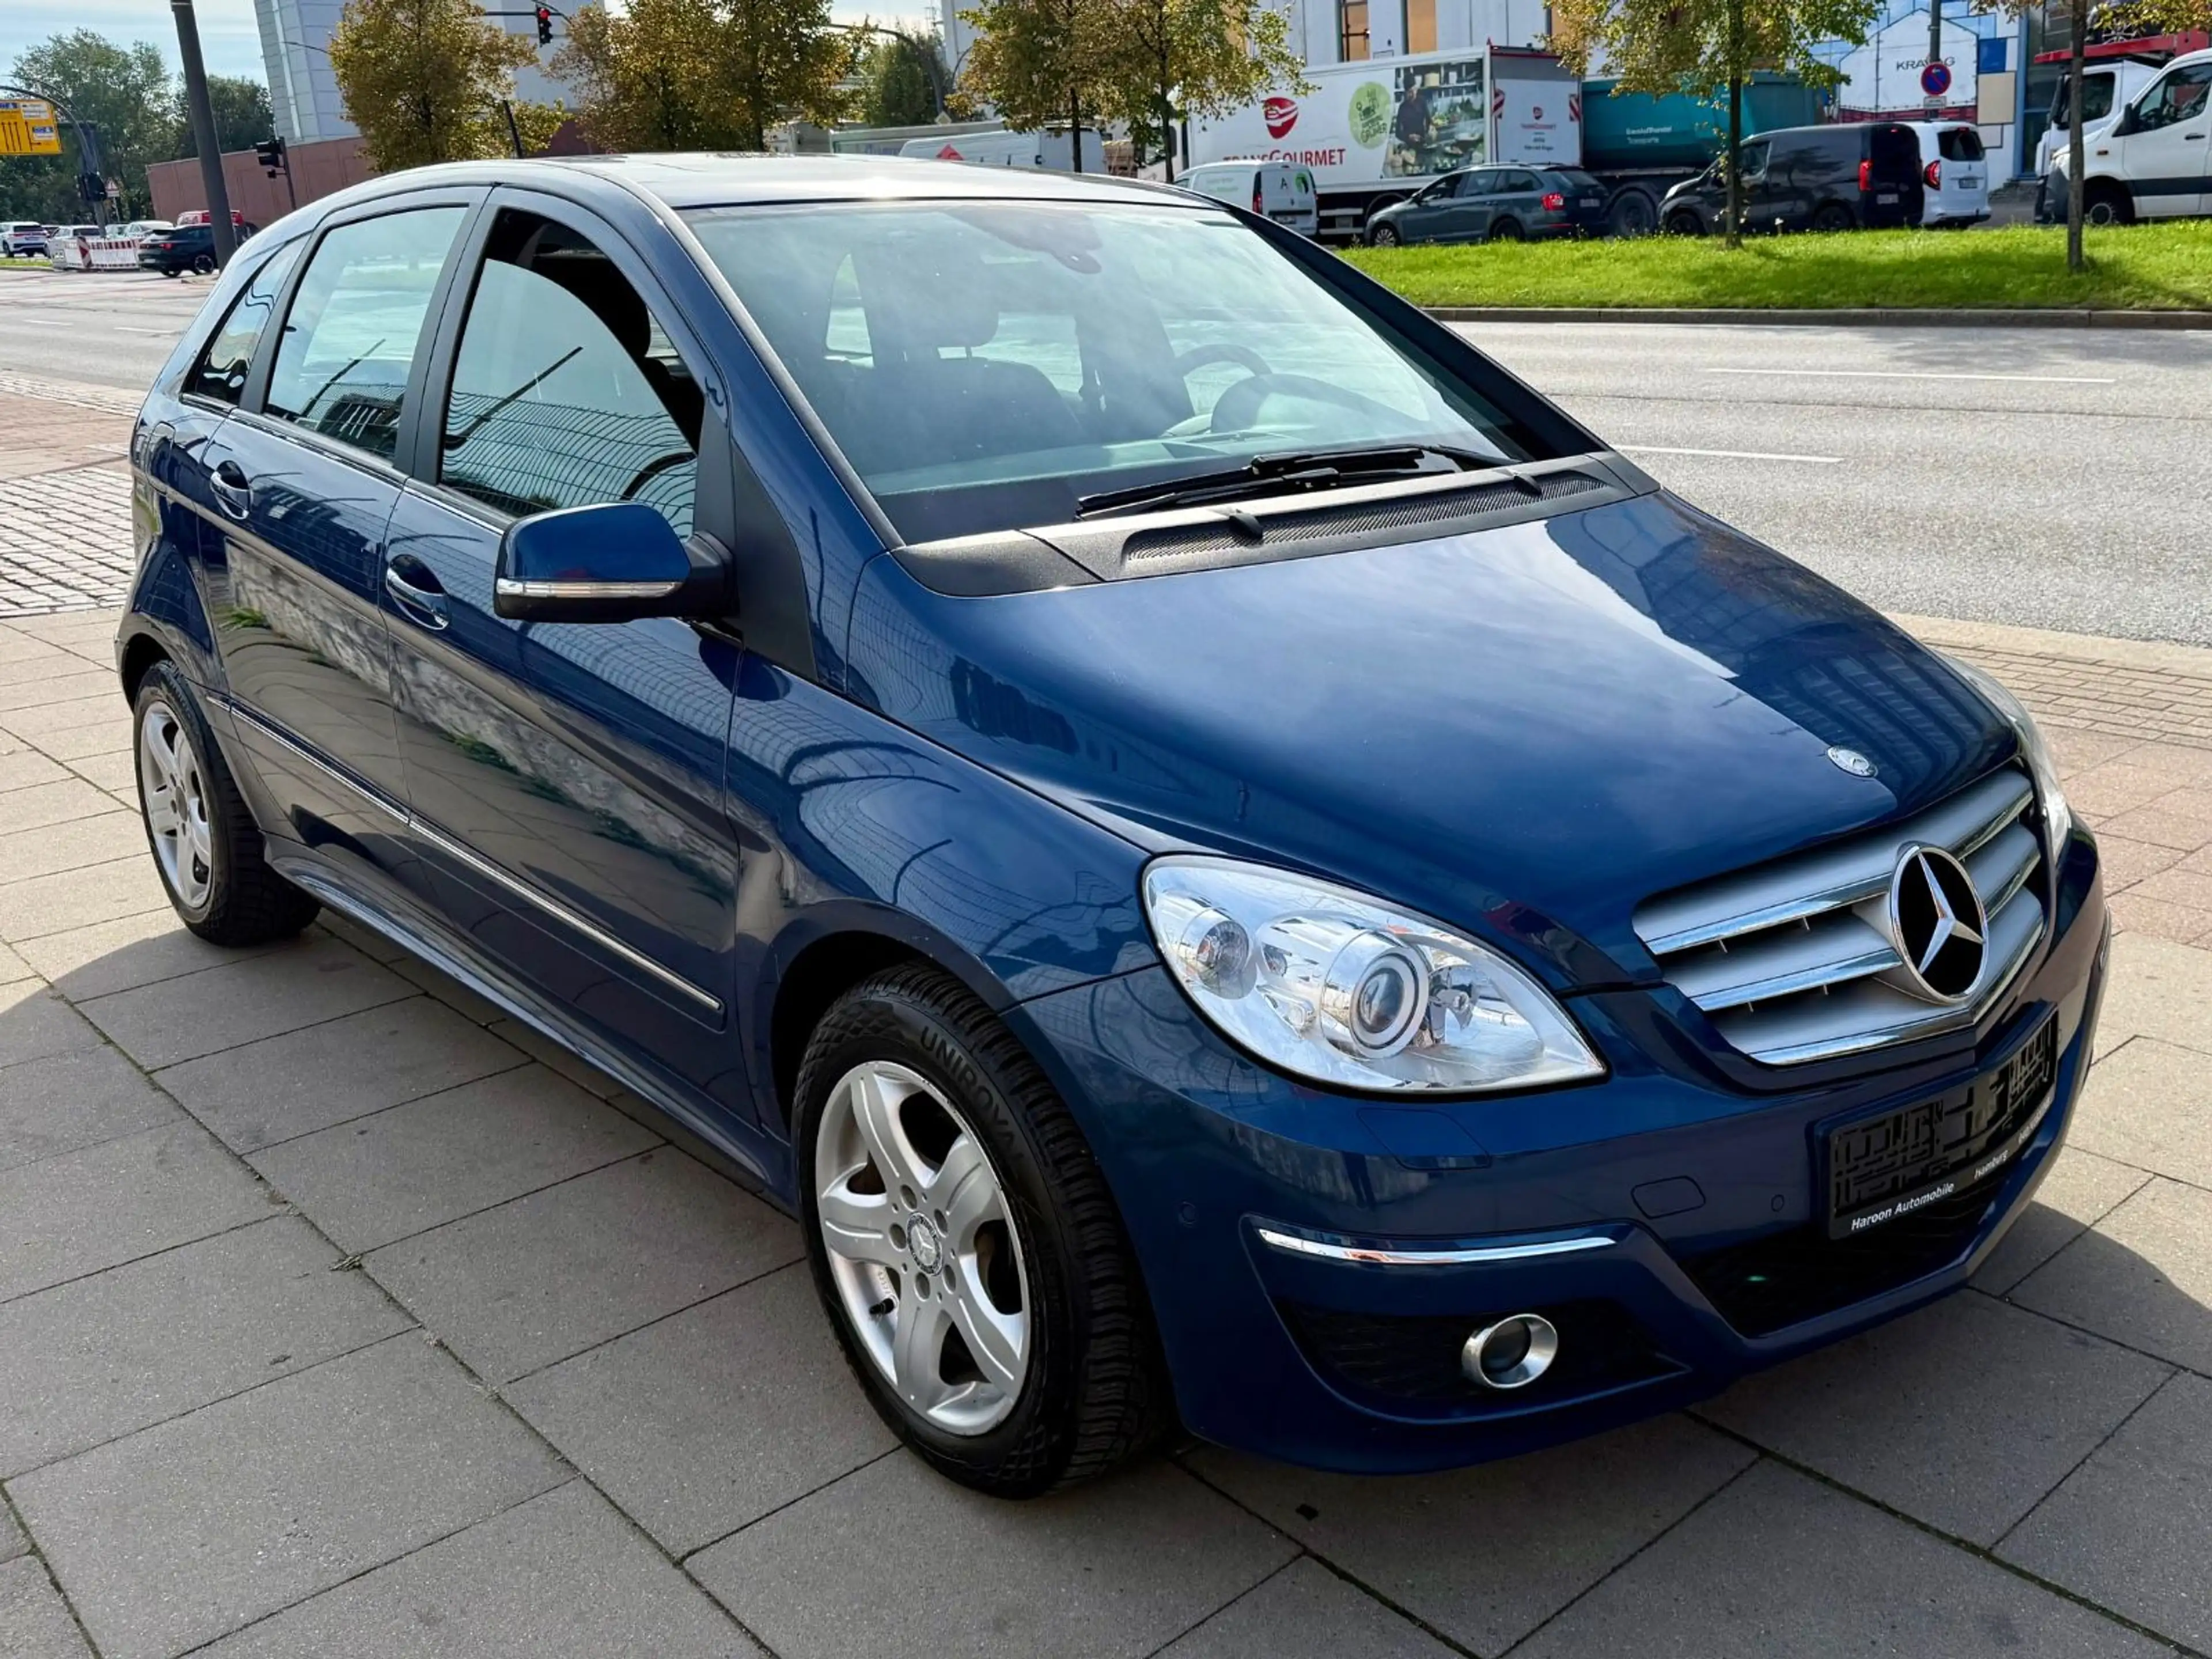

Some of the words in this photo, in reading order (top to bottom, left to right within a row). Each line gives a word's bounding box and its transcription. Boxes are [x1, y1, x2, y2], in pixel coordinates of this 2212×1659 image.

[1896, 56, 1956, 71] KRAG
[1223, 149, 1346, 166] GOURMET
[1851, 1207, 1892, 1230] Haroon
[1894, 1183, 1955, 1215] Automobile
